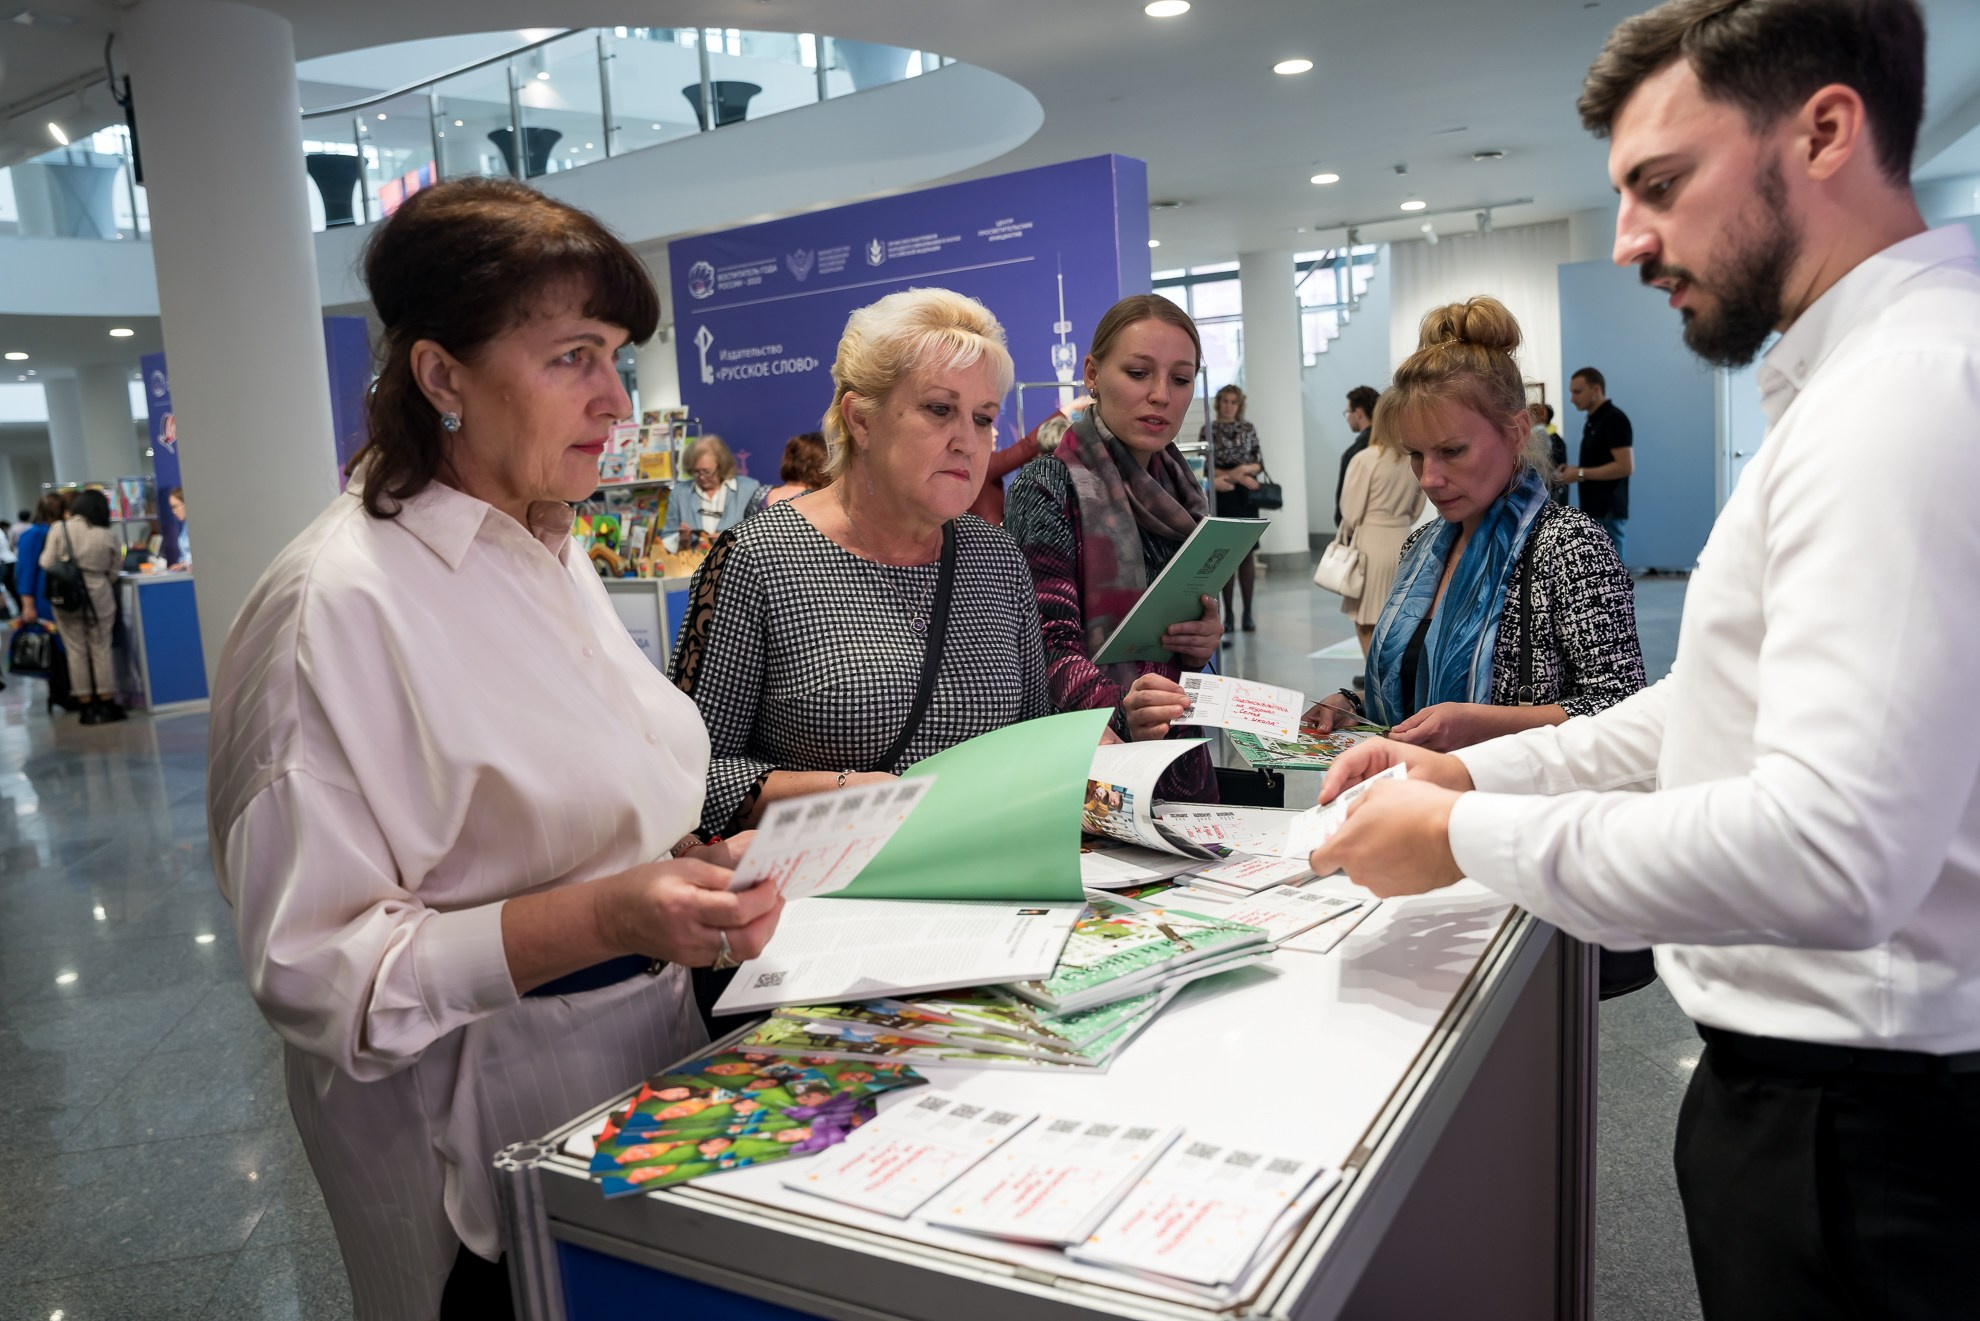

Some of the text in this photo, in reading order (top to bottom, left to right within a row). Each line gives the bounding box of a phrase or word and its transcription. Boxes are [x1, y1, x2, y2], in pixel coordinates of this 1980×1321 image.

[719, 344, 783, 361] Издательство
[716, 356, 819, 380] «РУССКОЕ СЛОВО»
